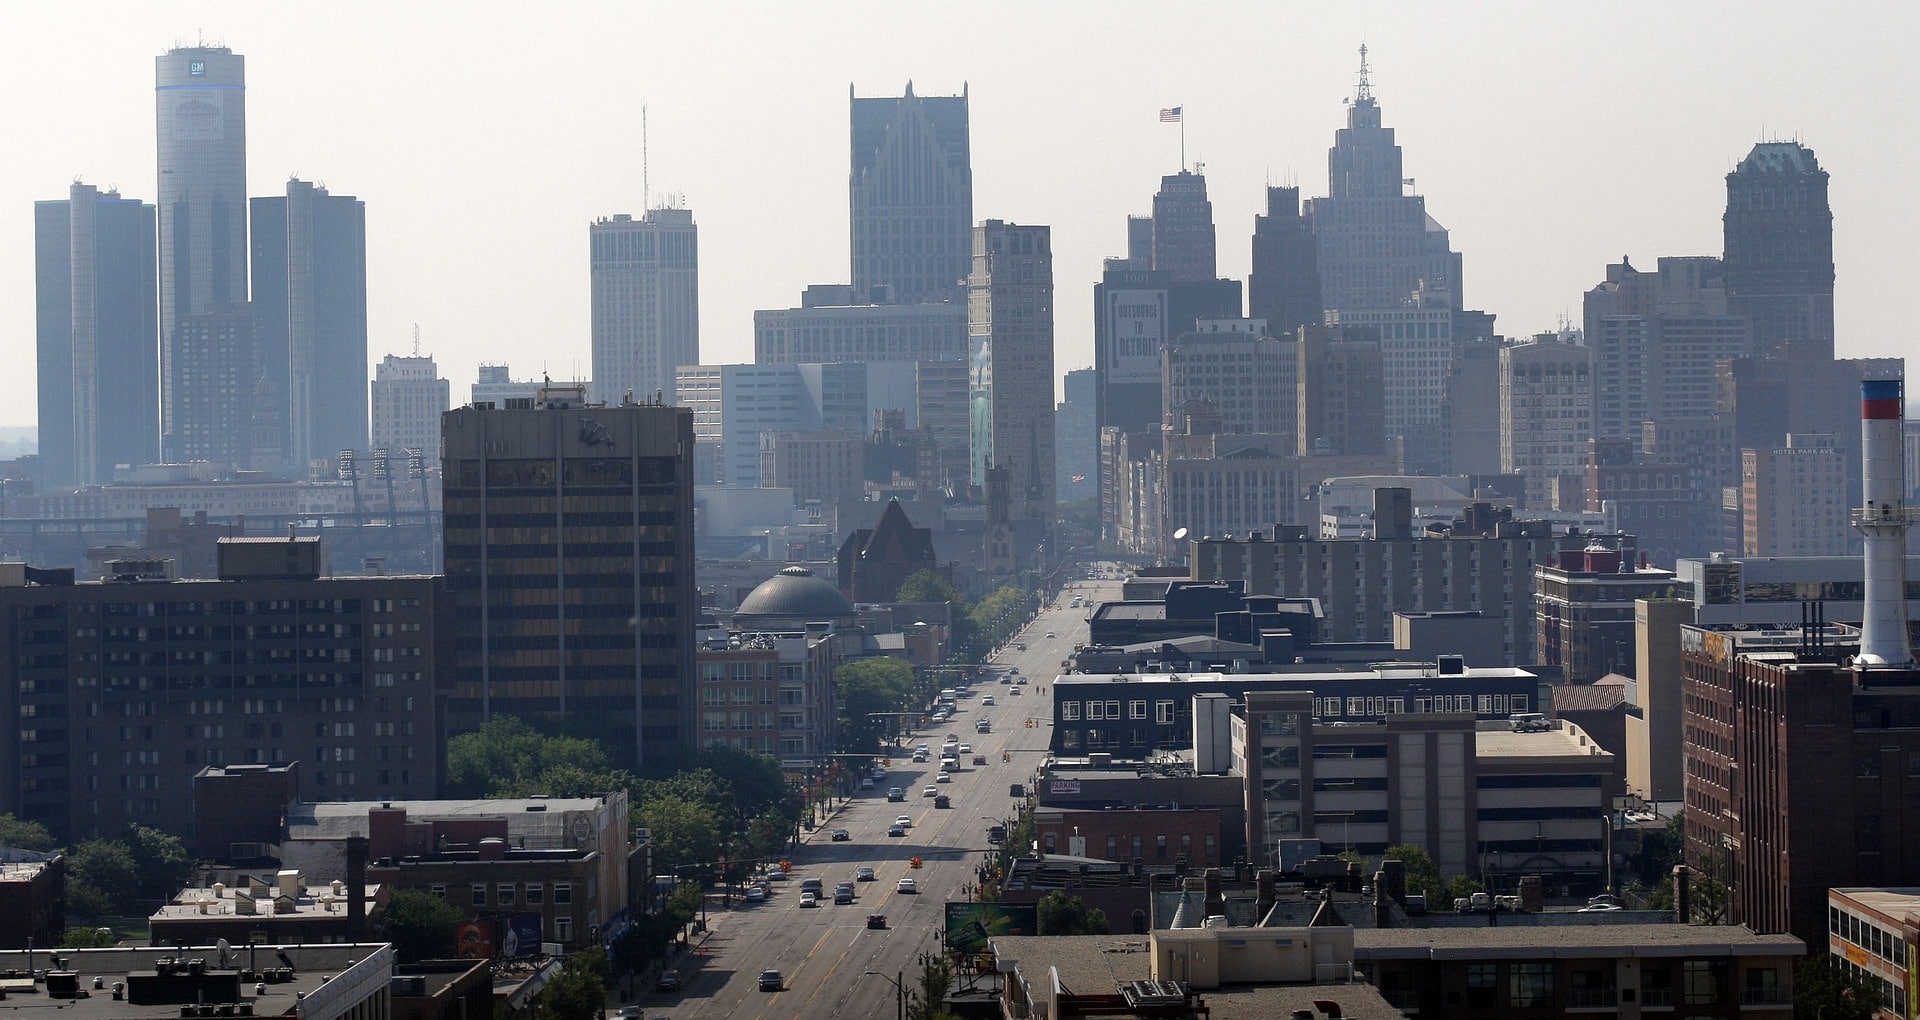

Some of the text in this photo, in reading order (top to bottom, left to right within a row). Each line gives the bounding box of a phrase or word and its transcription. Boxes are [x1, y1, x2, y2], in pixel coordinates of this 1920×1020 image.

[191, 62, 204, 72] GM
[1124, 274, 1149, 283] 1001
[1118, 303, 1158, 319] OUTSOURCE
[1134, 320, 1143, 335] TO
[1119, 337, 1157, 357] DETROIT
[1051, 781, 1080, 790] PARKING
